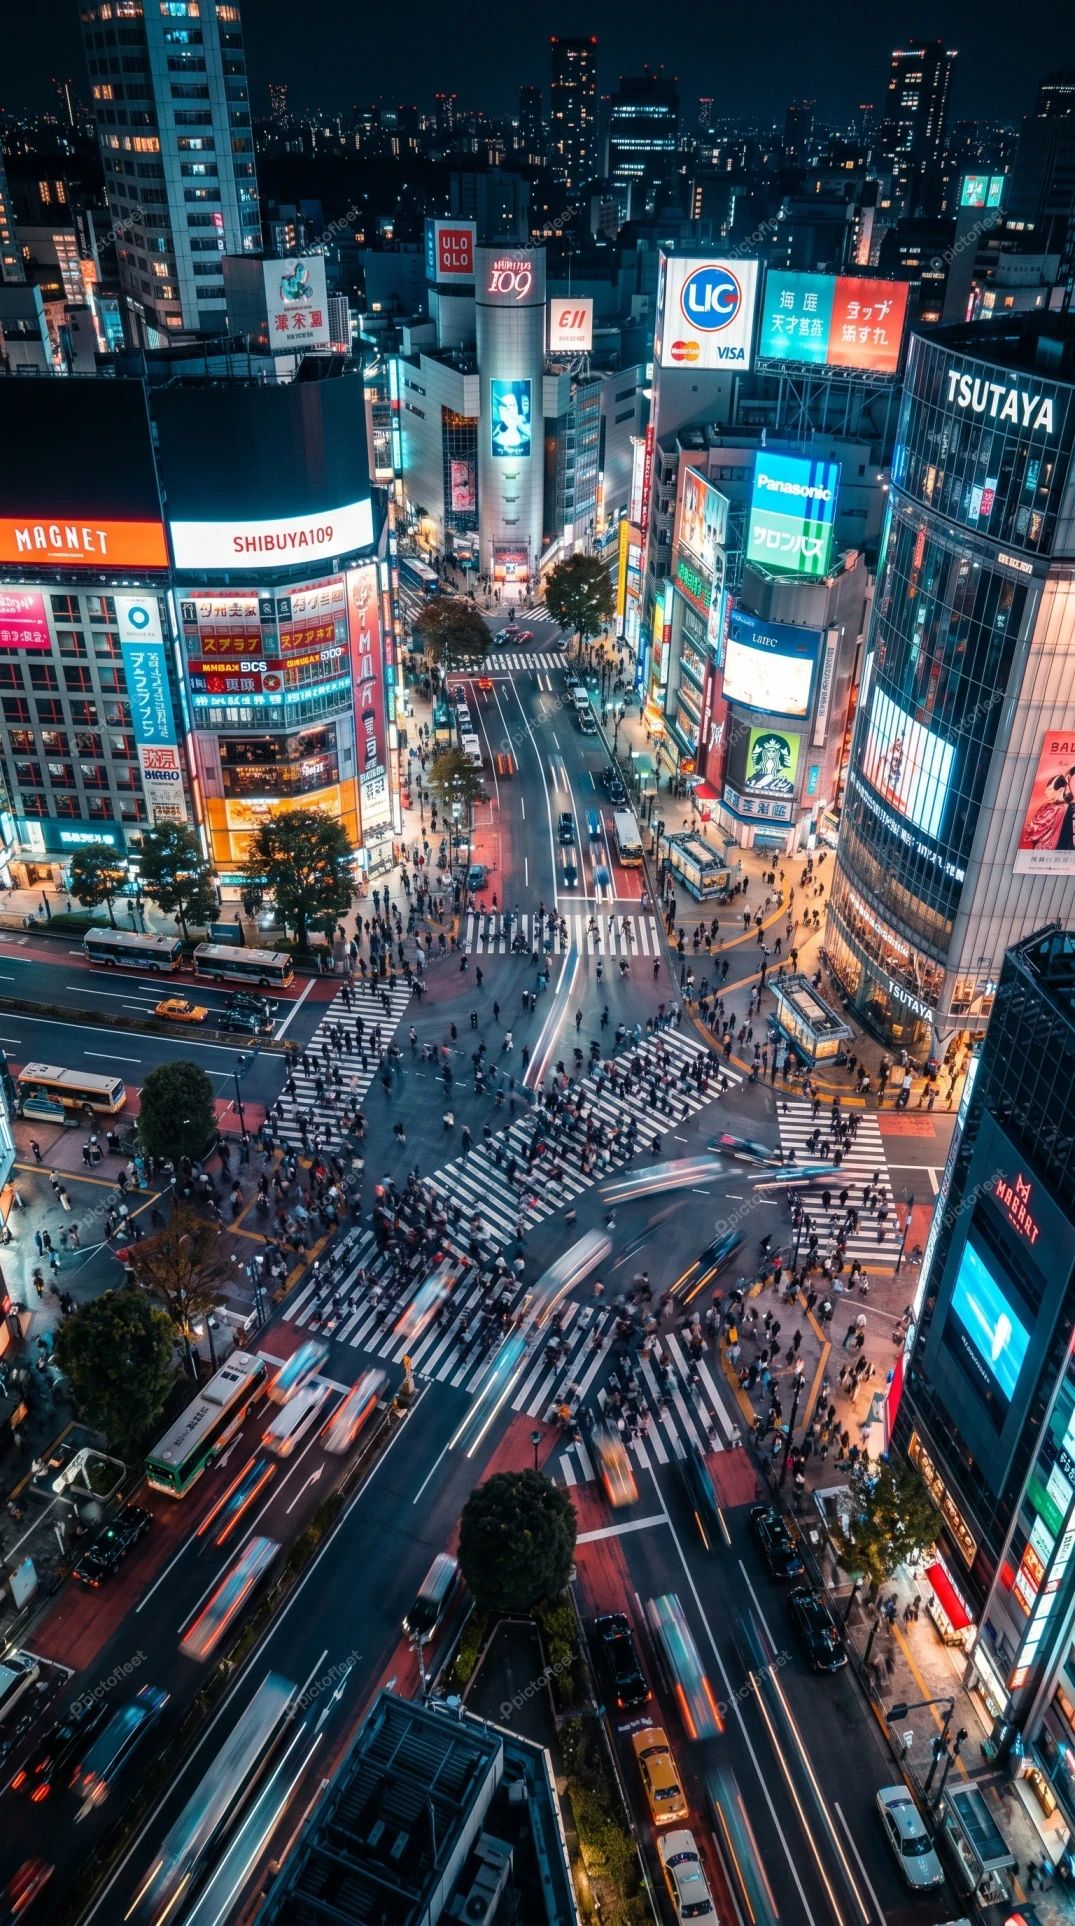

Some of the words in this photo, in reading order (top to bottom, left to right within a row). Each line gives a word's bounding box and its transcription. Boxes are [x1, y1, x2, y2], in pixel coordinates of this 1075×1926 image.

[443, 252, 468, 267] QLO
[717, 346, 745, 360] VISA
[948, 370, 1053, 433] TSUTAYA
[757, 473, 832, 501] Panasonic
[15, 525, 108, 555] MAGNET
[233, 525, 334, 553] SHIBUYA109
[888, 981, 933, 1022] TSUTAYA
